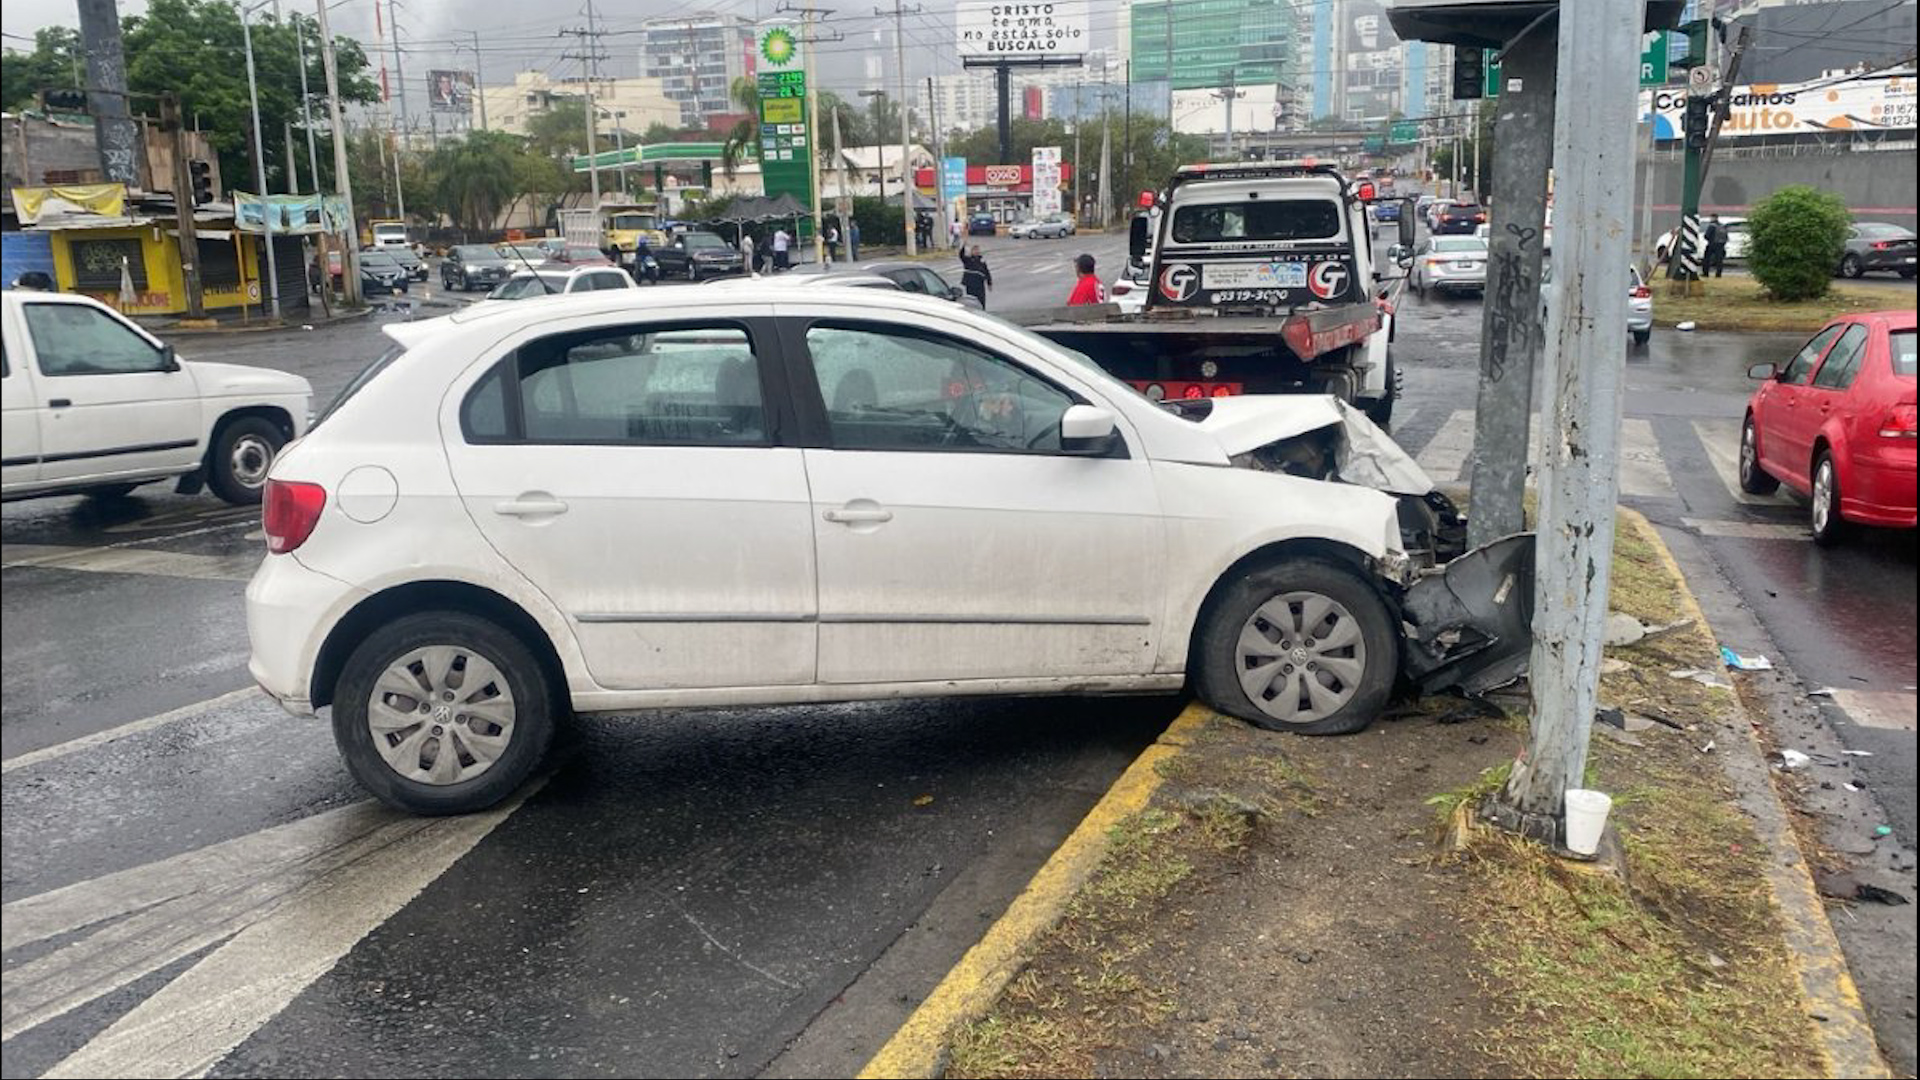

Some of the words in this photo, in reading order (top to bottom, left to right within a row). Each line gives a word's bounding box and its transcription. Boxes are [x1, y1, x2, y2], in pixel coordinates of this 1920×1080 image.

[991, 4, 1054, 15] CRISTO
[992, 17, 1009, 27] te
[964, 29, 983, 40] no
[991, 26, 1038, 40] estás
[1046, 26, 1081, 39] solo
[987, 40, 1057, 51] BUSCALO
[1656, 91, 1797, 110] Coamos
